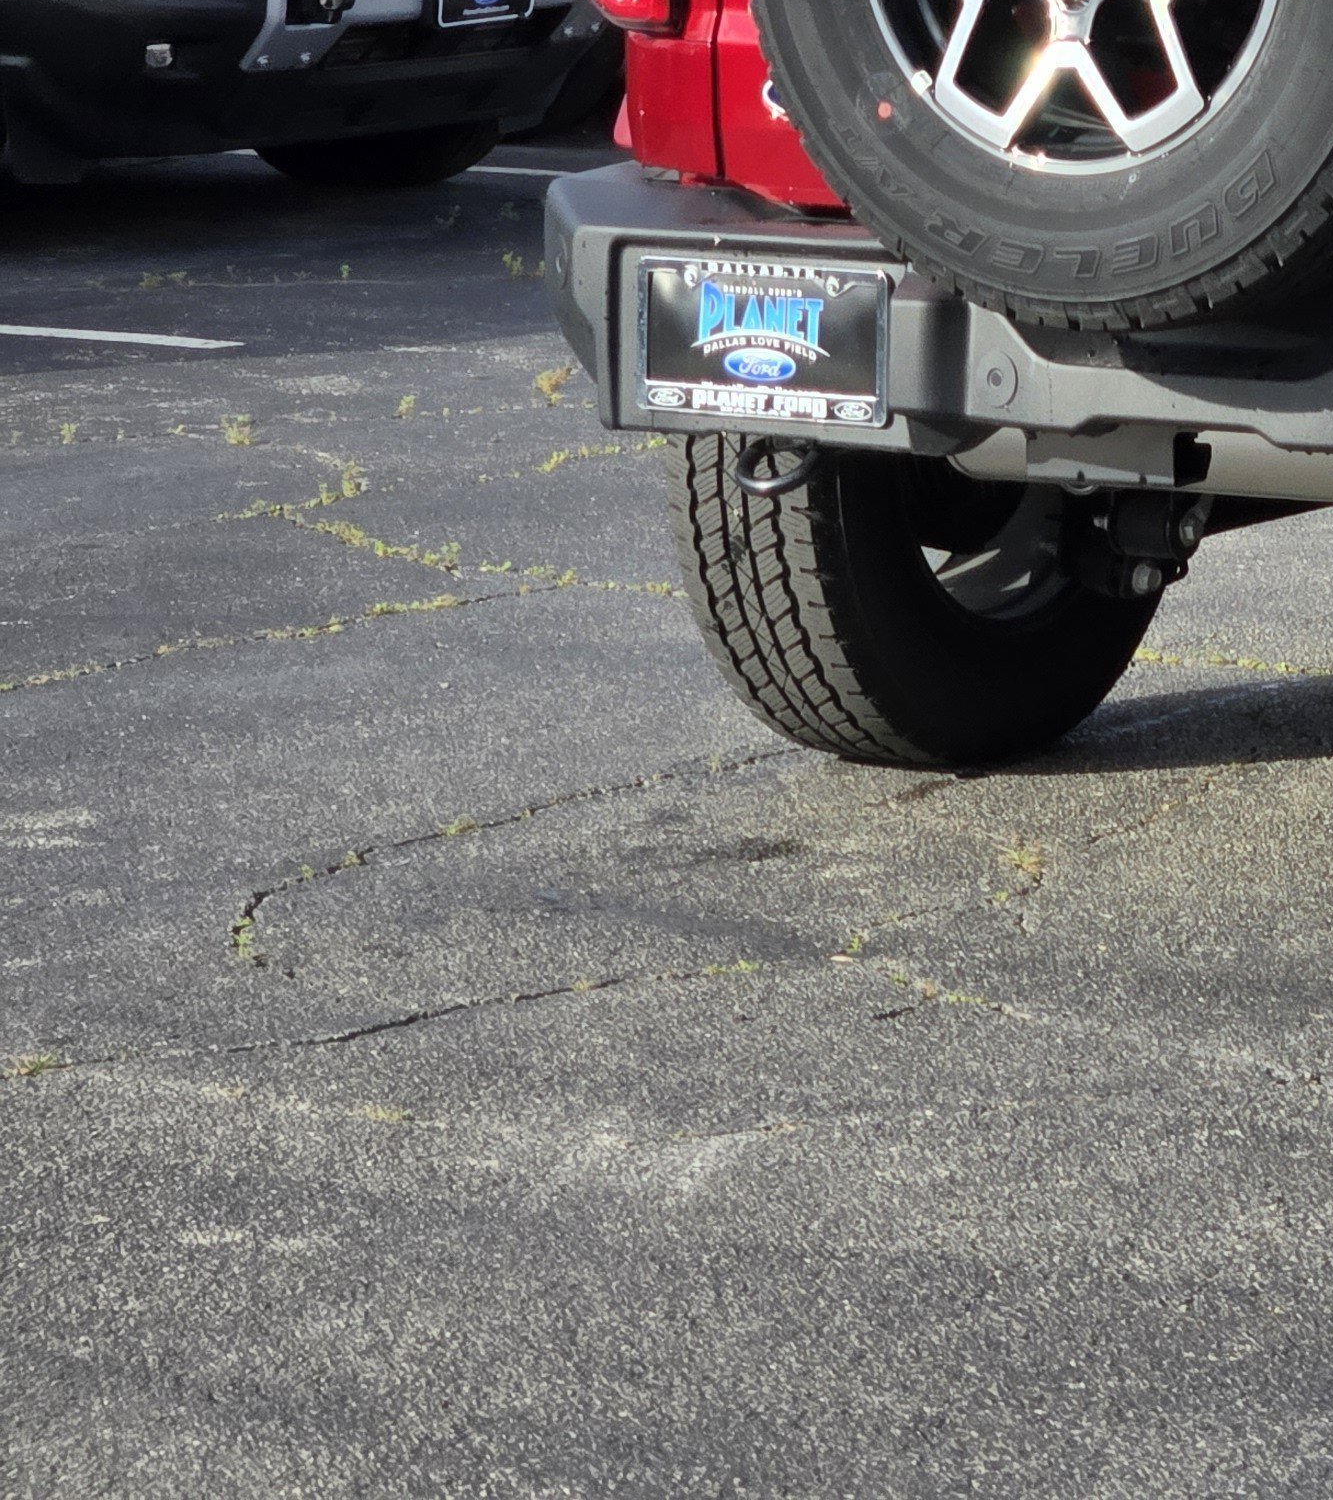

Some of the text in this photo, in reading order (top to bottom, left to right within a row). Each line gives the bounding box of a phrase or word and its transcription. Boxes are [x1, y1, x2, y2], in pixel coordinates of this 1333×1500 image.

[925, 149, 1277, 280] DUELER
[699, 280, 824, 346] PLANET
[703, 334, 818, 362] DALLAS LOVE FIELD
[738, 355, 781, 377] Ford
[692, 389, 768, 409] PLANET
[773, 395, 828, 418] FORD
